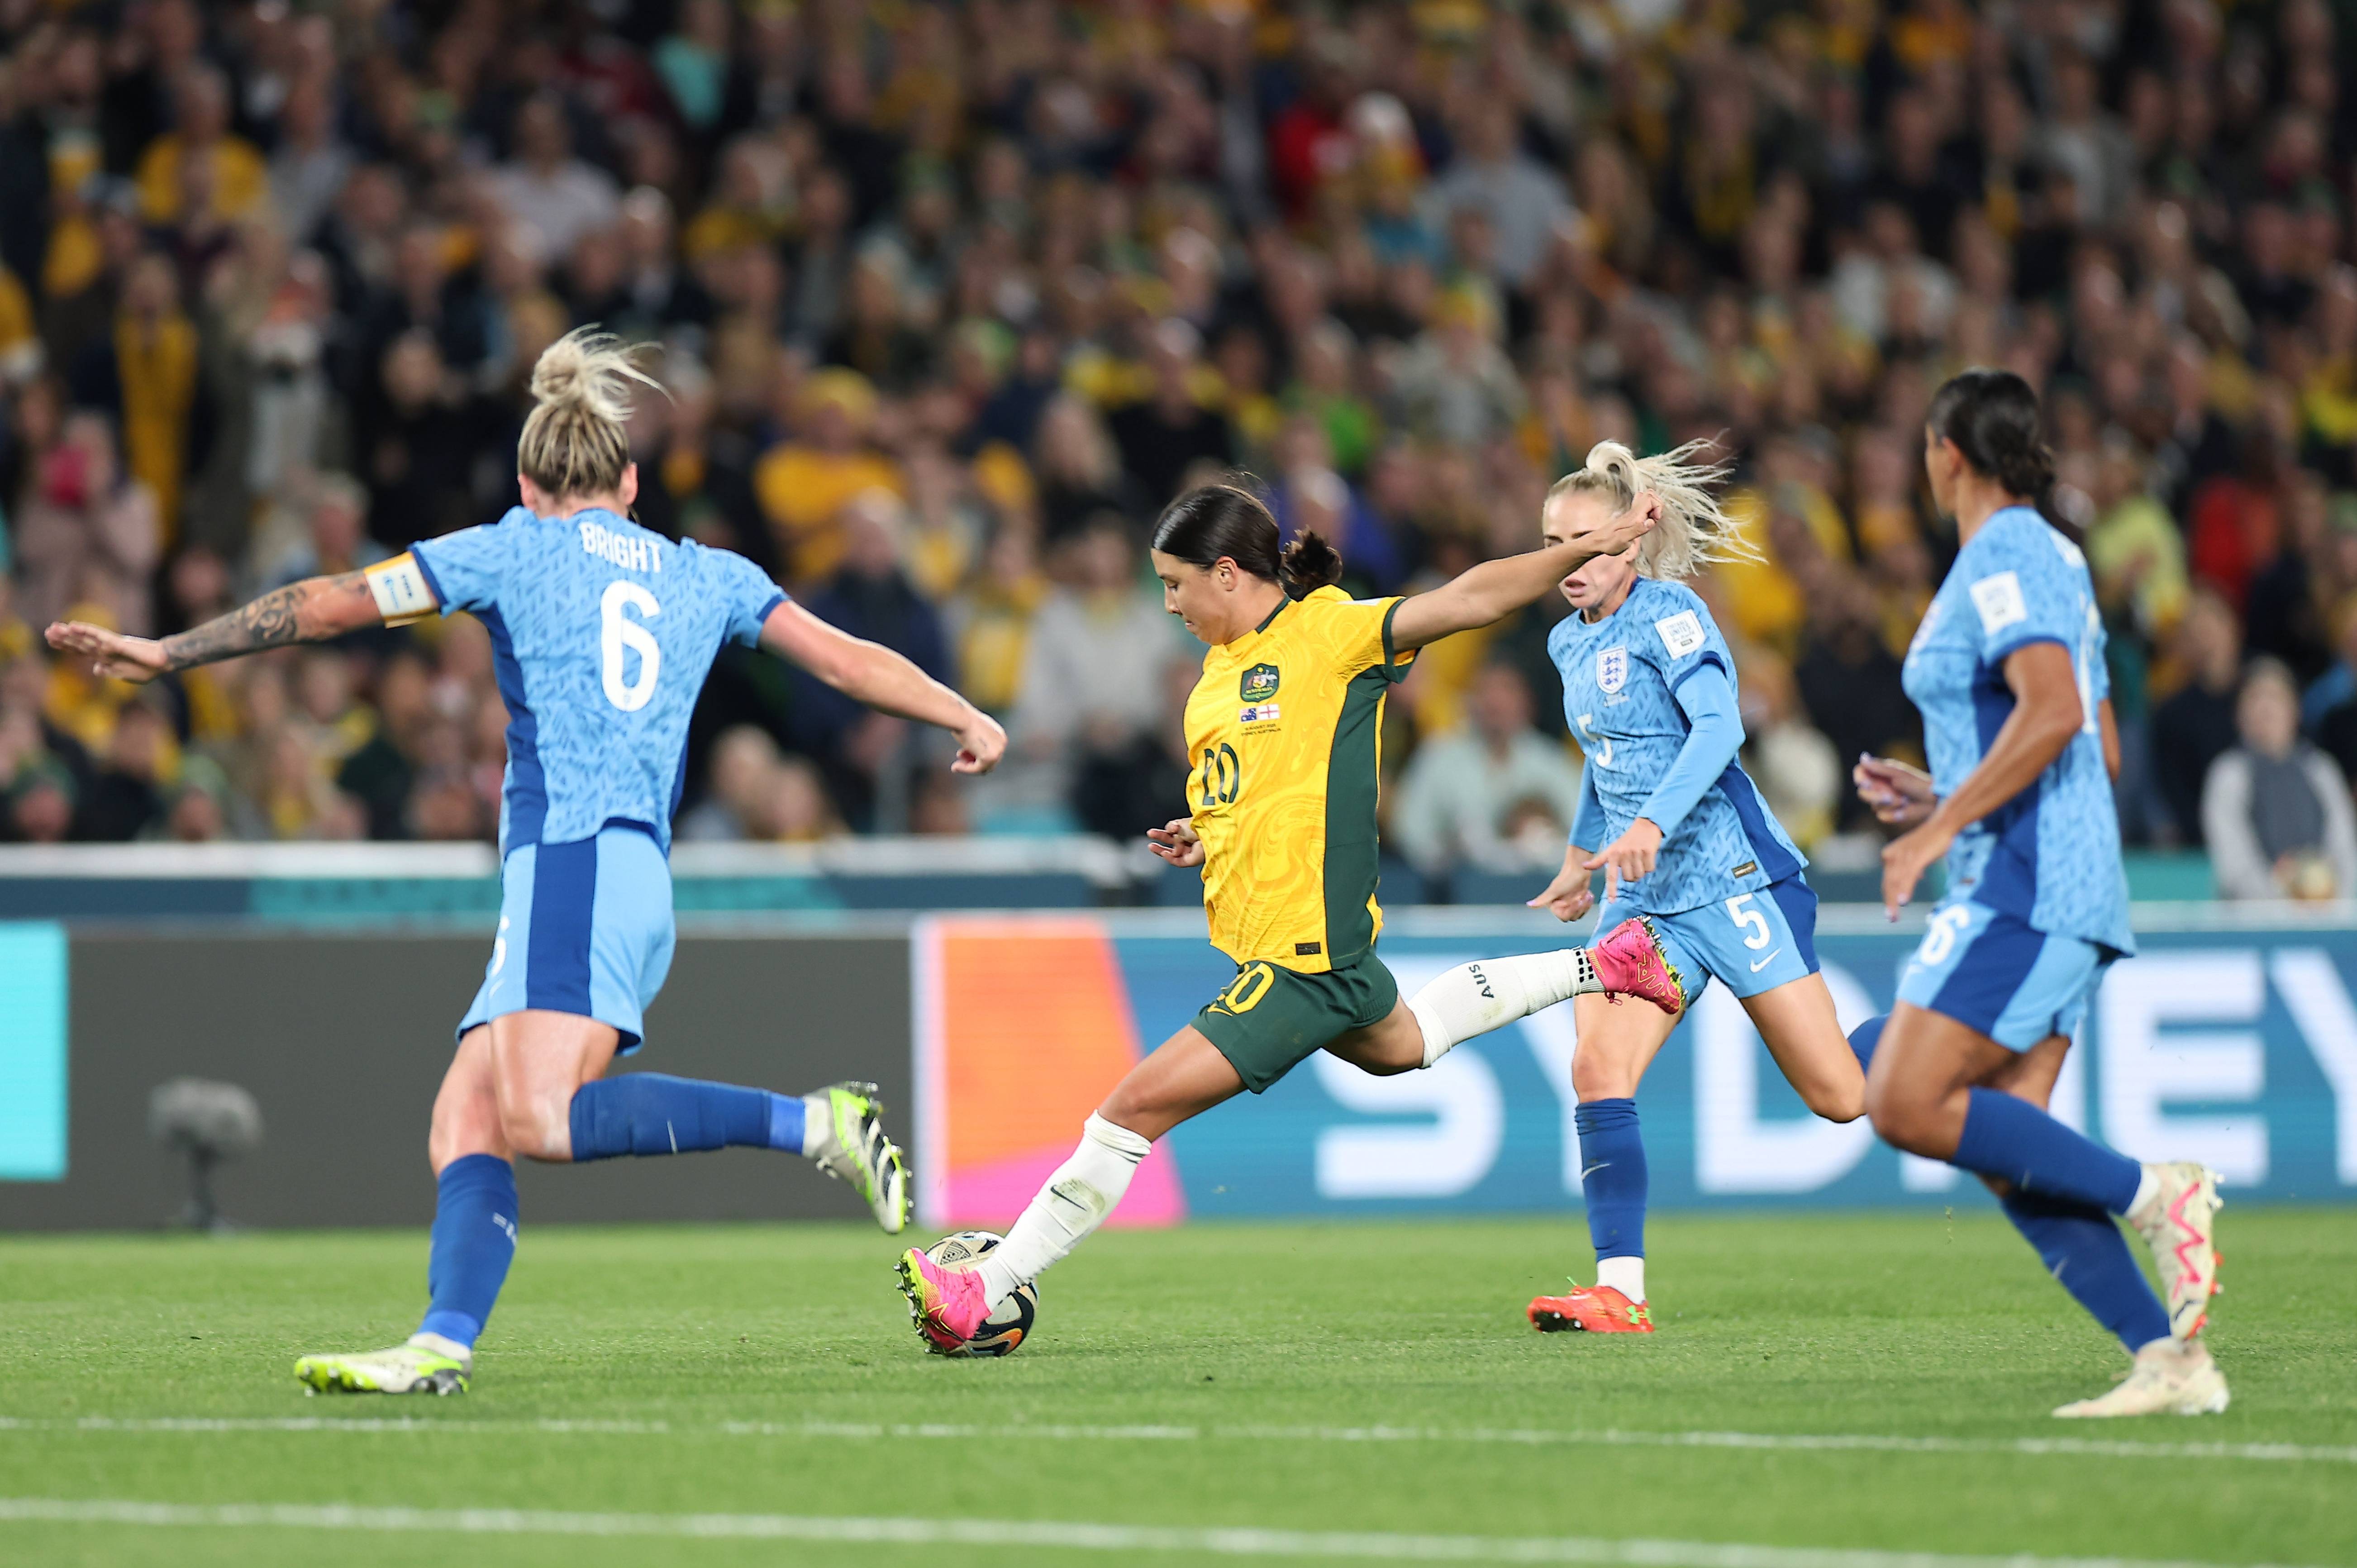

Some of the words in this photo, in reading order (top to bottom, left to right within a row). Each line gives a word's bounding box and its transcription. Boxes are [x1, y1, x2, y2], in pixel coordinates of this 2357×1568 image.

[579, 521, 661, 573] BRIGHT
[600, 579, 661, 712] 6
[1202, 742, 1239, 805] 20
[1724, 892, 1771, 950] 5
[1921, 904, 1970, 966] 6
[1469, 964, 1495, 999] AUS
[1311, 948, 2357, 1200] SDE
